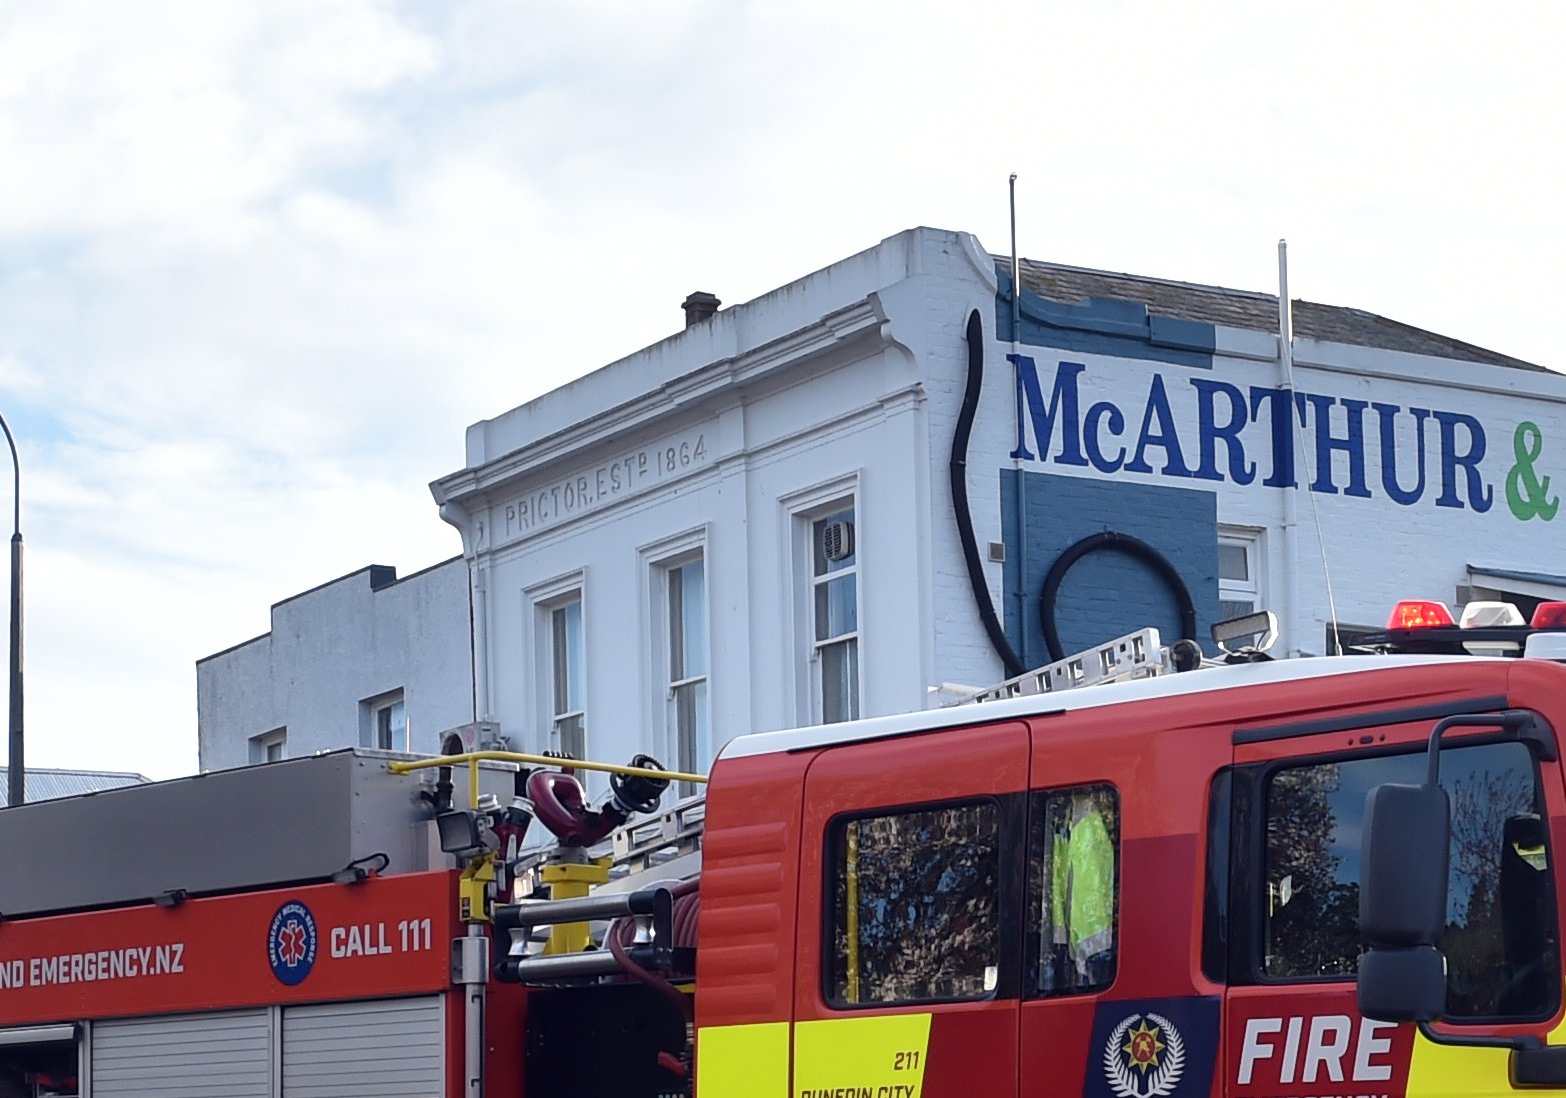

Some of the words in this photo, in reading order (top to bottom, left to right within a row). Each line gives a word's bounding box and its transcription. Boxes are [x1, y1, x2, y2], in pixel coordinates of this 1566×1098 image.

[657, 433, 707, 477] 1864
[1007, 353, 1496, 515] McARTHUR
[1505, 420, 1559, 523] &
[331, 922, 393, 958] CALL
[398, 918, 431, 951] 111
[30, 943, 184, 987] EMERGENCY.NZ
[893, 1050, 920, 1071] 211
[1237, 1014, 1399, 1085] FIRE
